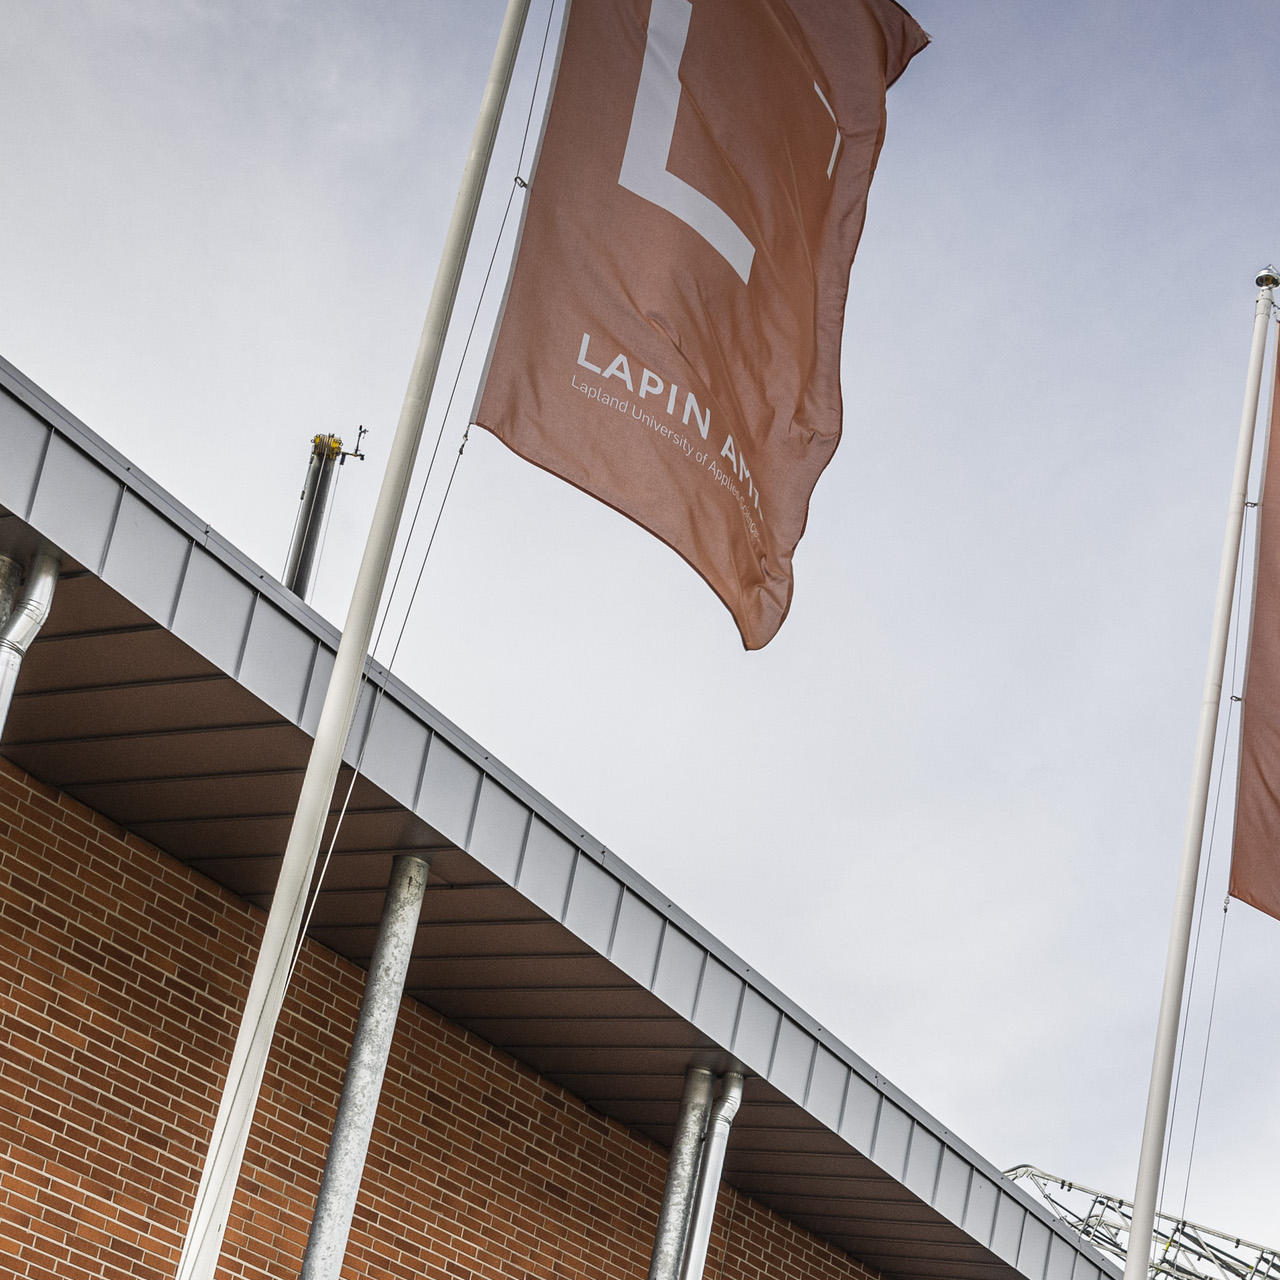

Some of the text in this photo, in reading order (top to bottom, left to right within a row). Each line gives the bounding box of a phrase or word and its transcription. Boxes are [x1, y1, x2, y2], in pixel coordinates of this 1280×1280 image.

[571, 374, 629, 413] Lapland
[631, 405, 694, 456] University
[696, 451, 708, 466] of
[577, 332, 711, 440] LAPIN
